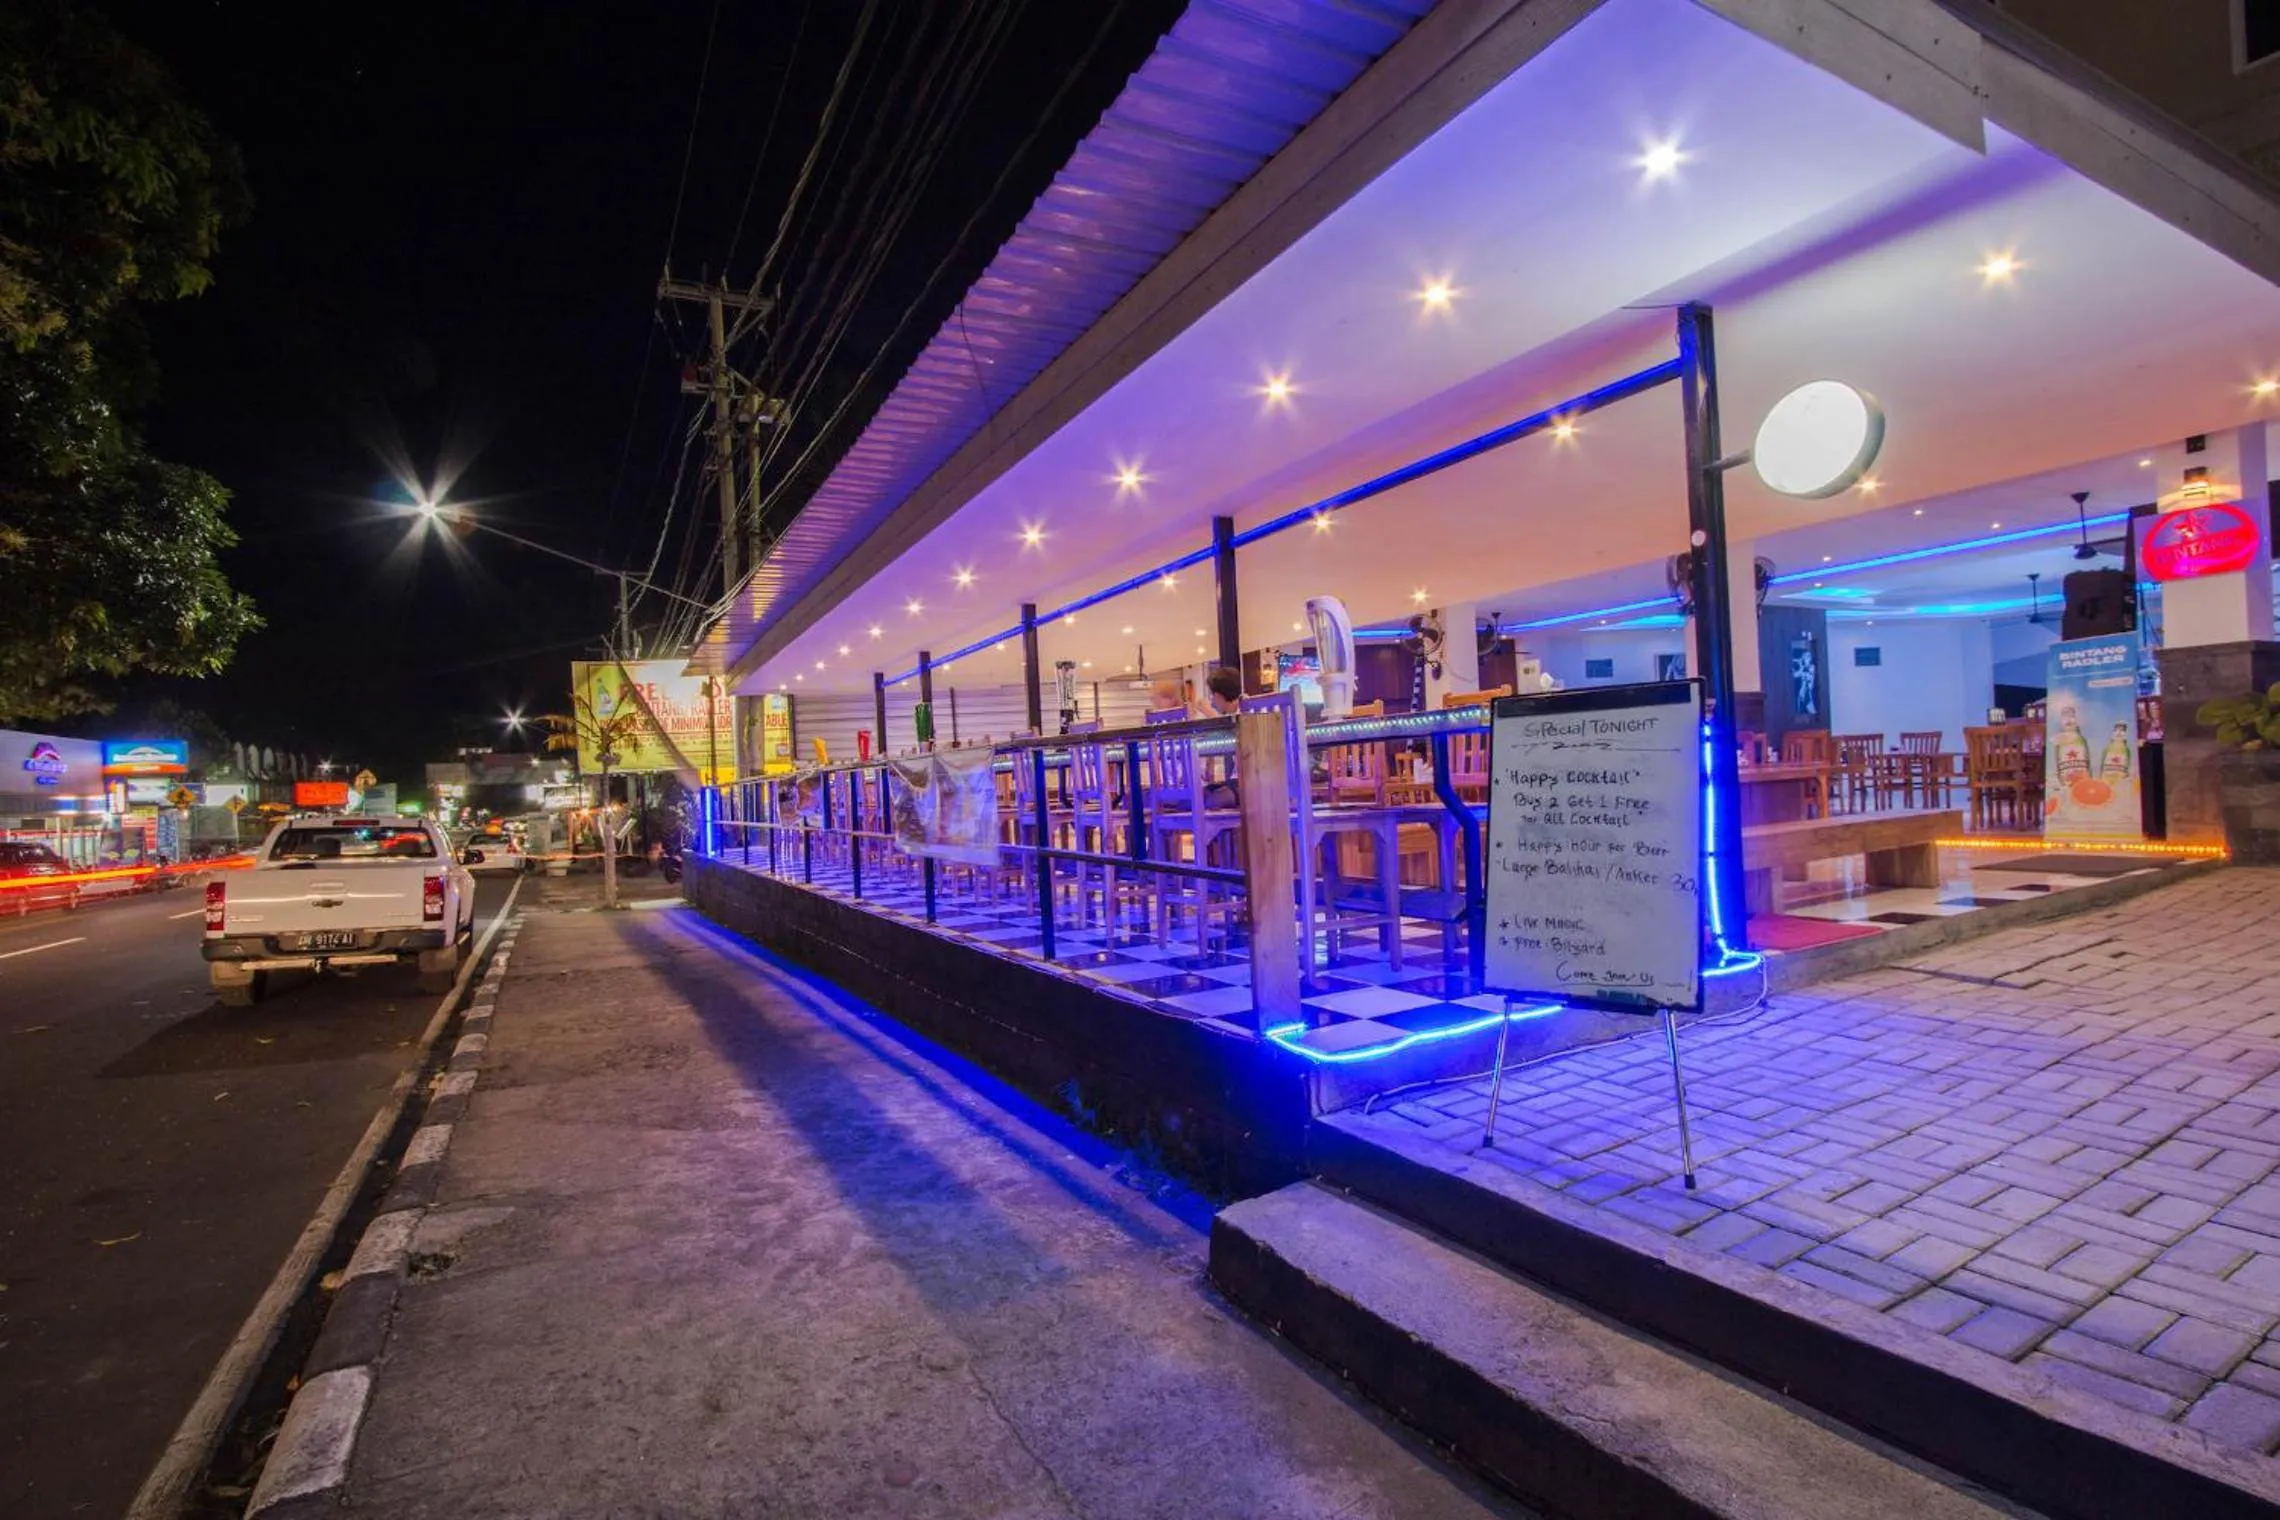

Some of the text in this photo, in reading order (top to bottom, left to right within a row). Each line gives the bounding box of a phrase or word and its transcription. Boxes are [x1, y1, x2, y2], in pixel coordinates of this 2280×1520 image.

[1590, 717, 1660, 734] TONIGHT
[1549, 796, 1560, 808] 2
[1567, 794, 1594, 808] Get
